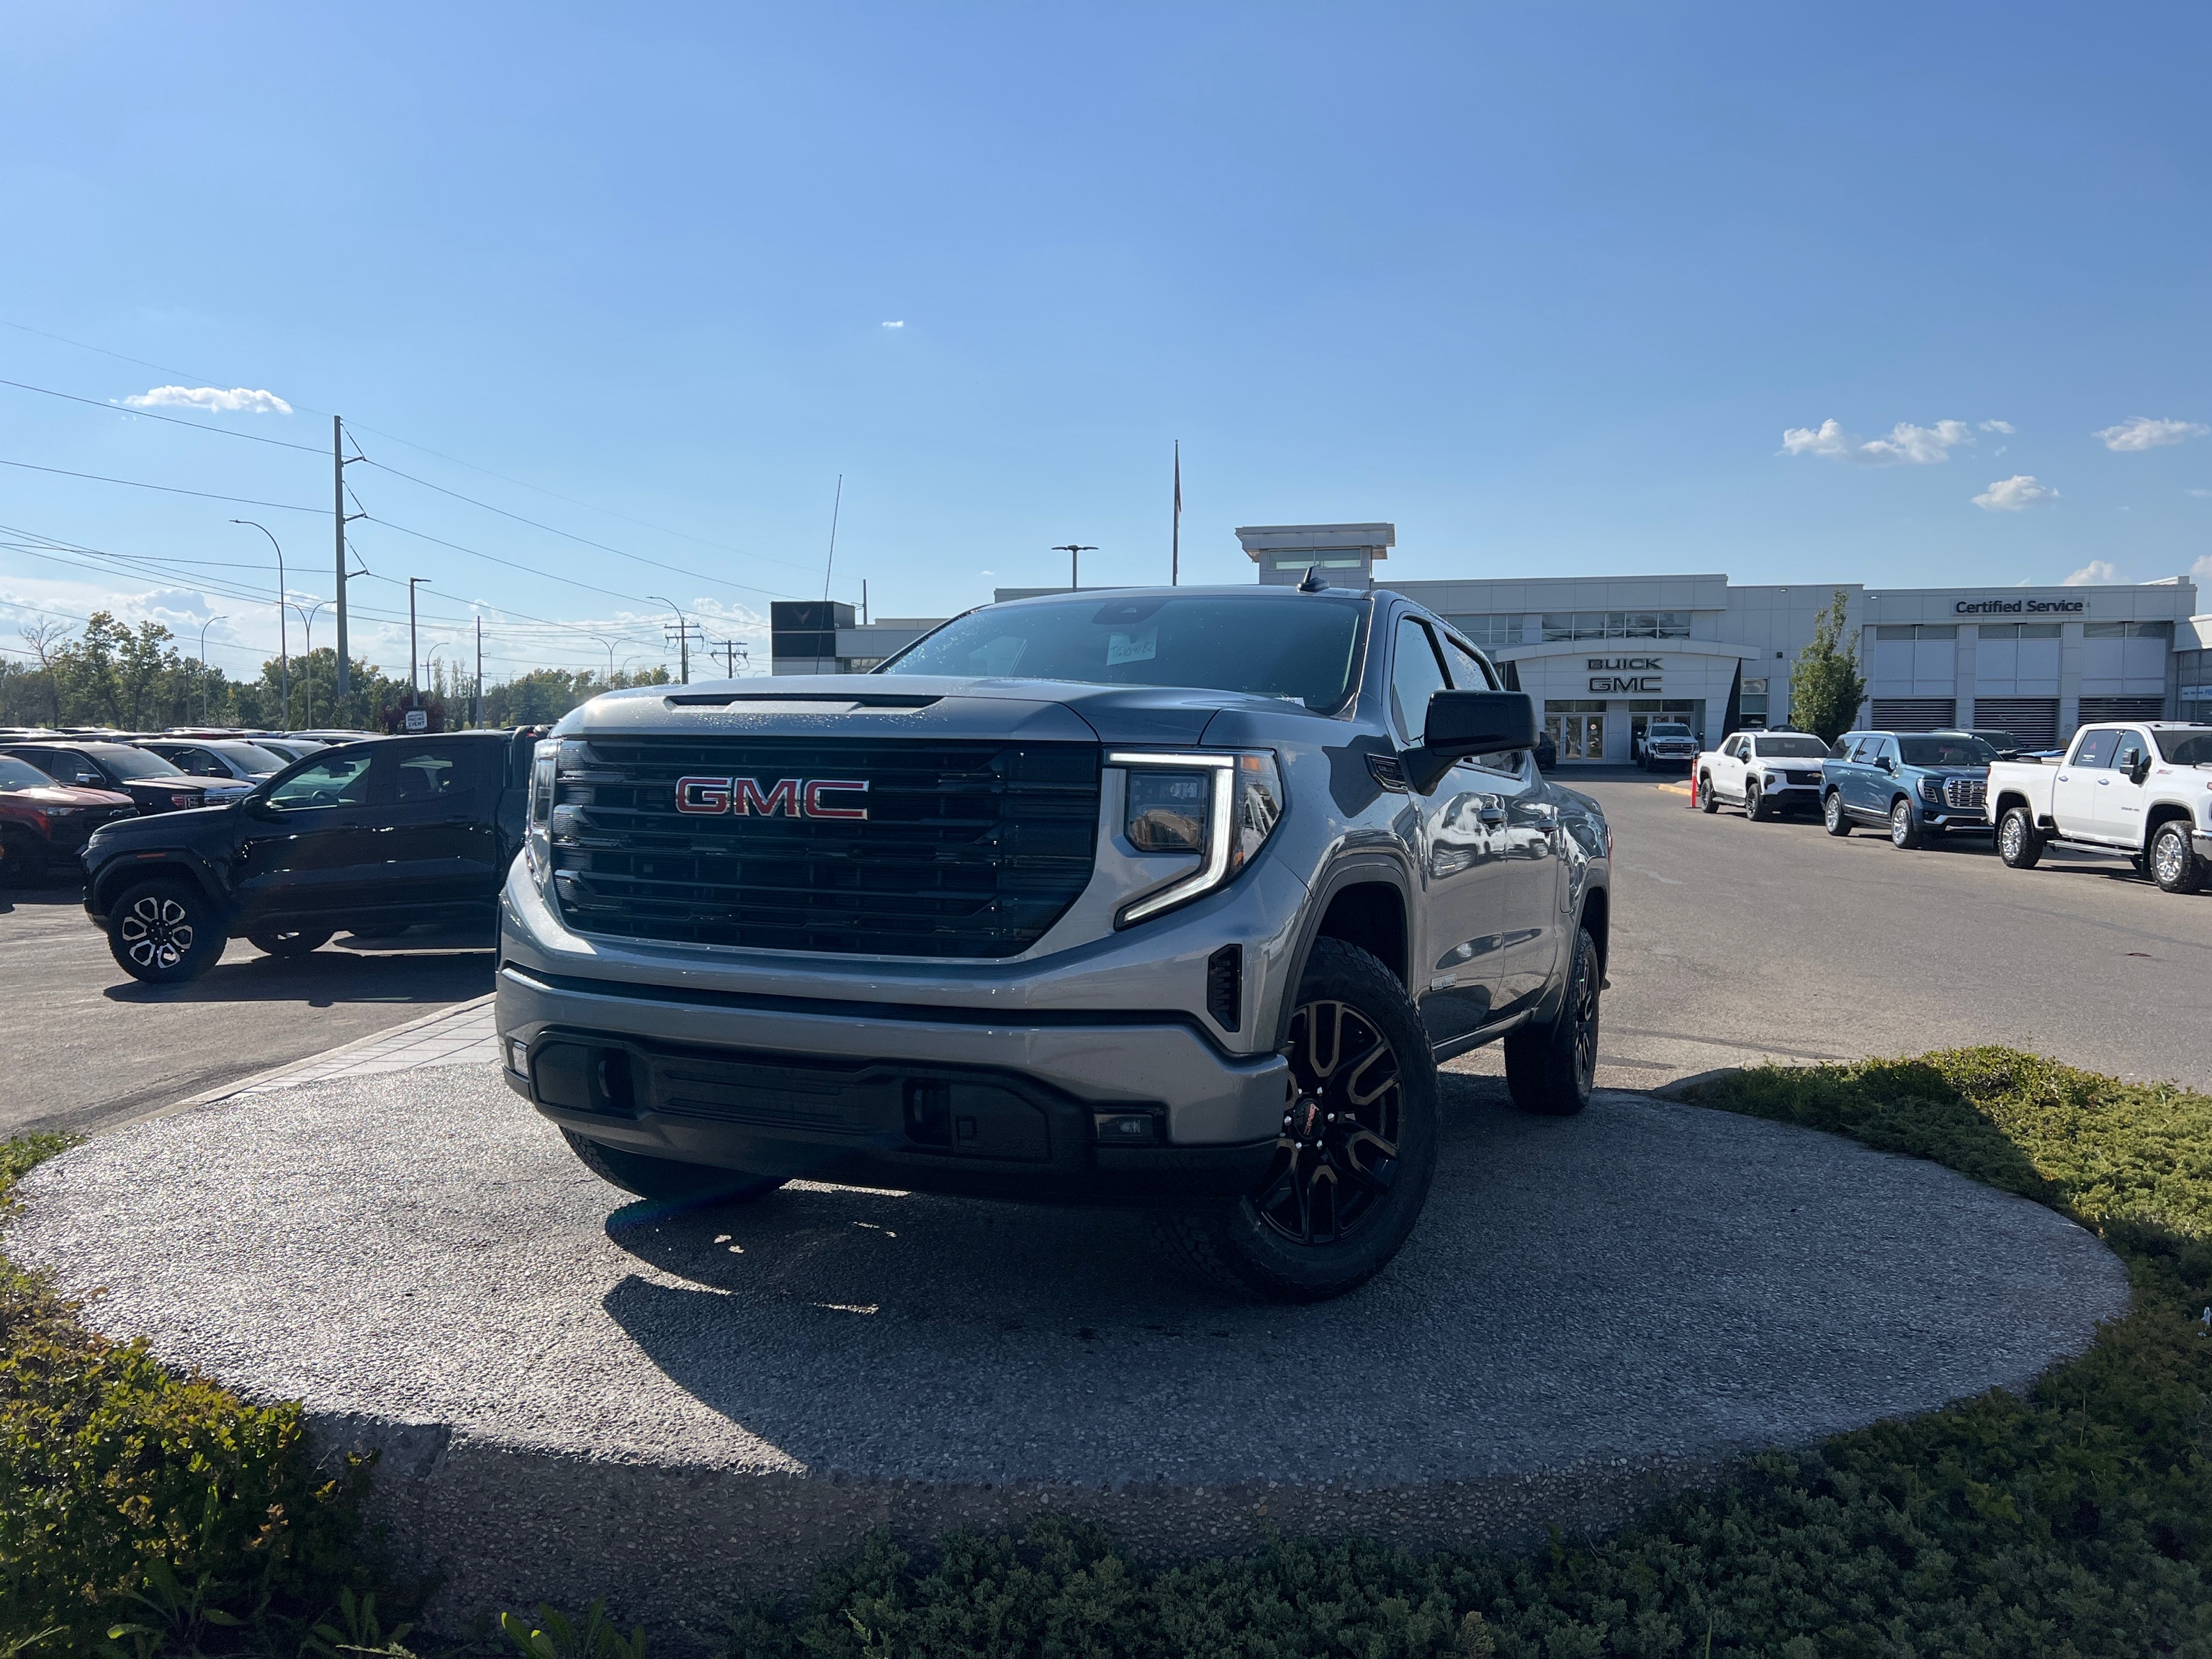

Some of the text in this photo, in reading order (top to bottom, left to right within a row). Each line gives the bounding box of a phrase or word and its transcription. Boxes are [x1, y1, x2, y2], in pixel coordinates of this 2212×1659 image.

[1956, 600, 2083, 613] Certified Service
[1587, 658, 1664, 670] BUICK
[1588, 676, 1663, 693] GMC
[675, 776, 869, 820] GMC
[1303, 1103, 1318, 1136] GMC
